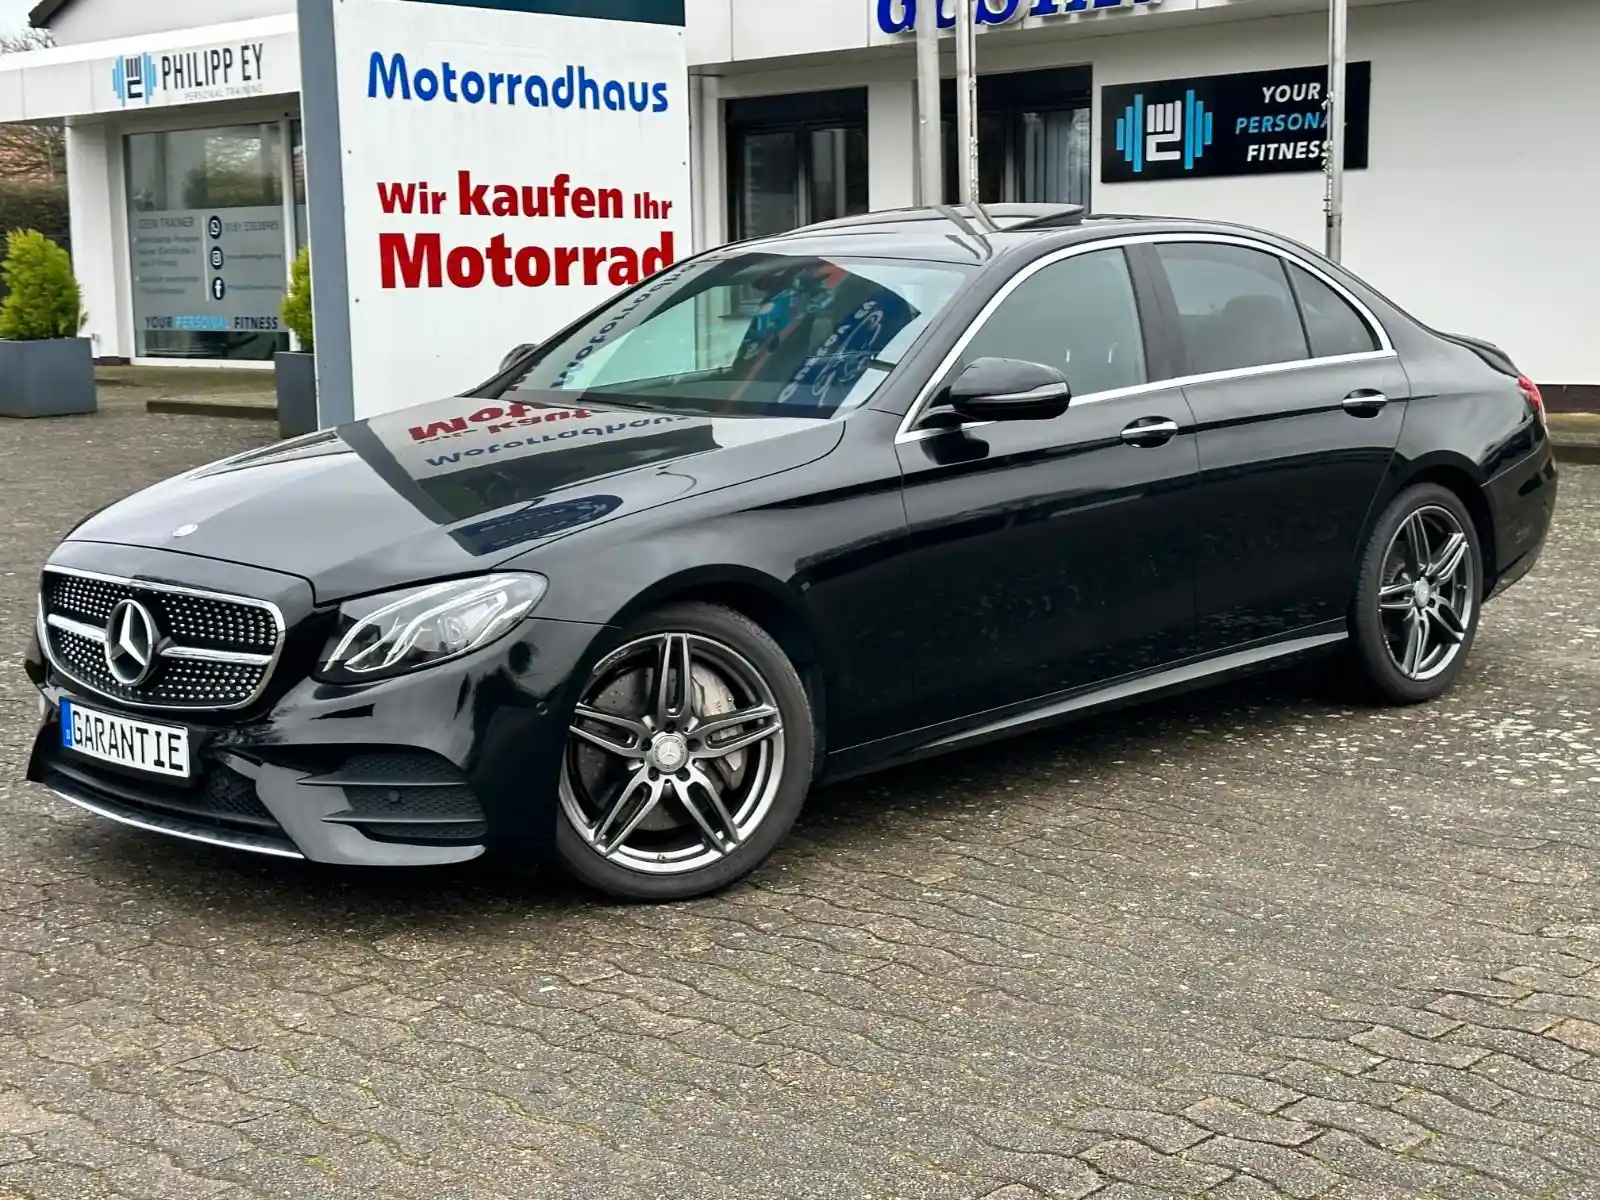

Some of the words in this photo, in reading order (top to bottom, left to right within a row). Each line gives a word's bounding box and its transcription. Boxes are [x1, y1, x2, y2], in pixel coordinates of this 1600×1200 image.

[161, 47, 233, 91] PHILIPP
[241, 43, 263, 82] EY
[368, 51, 669, 113] Motorradhaus
[1262, 82, 1321, 104] YOUR
[1235, 111, 1346, 135] PERSON
[377, 181, 447, 215] Wir
[458, 170, 623, 218] kaufen
[634, 192, 672, 219] Ihr
[379, 231, 674, 288] Motorrad
[144, 316, 173, 329] YOUR
[234, 316, 278, 330] FITNESS
[72, 710, 184, 772] GARANTIE
